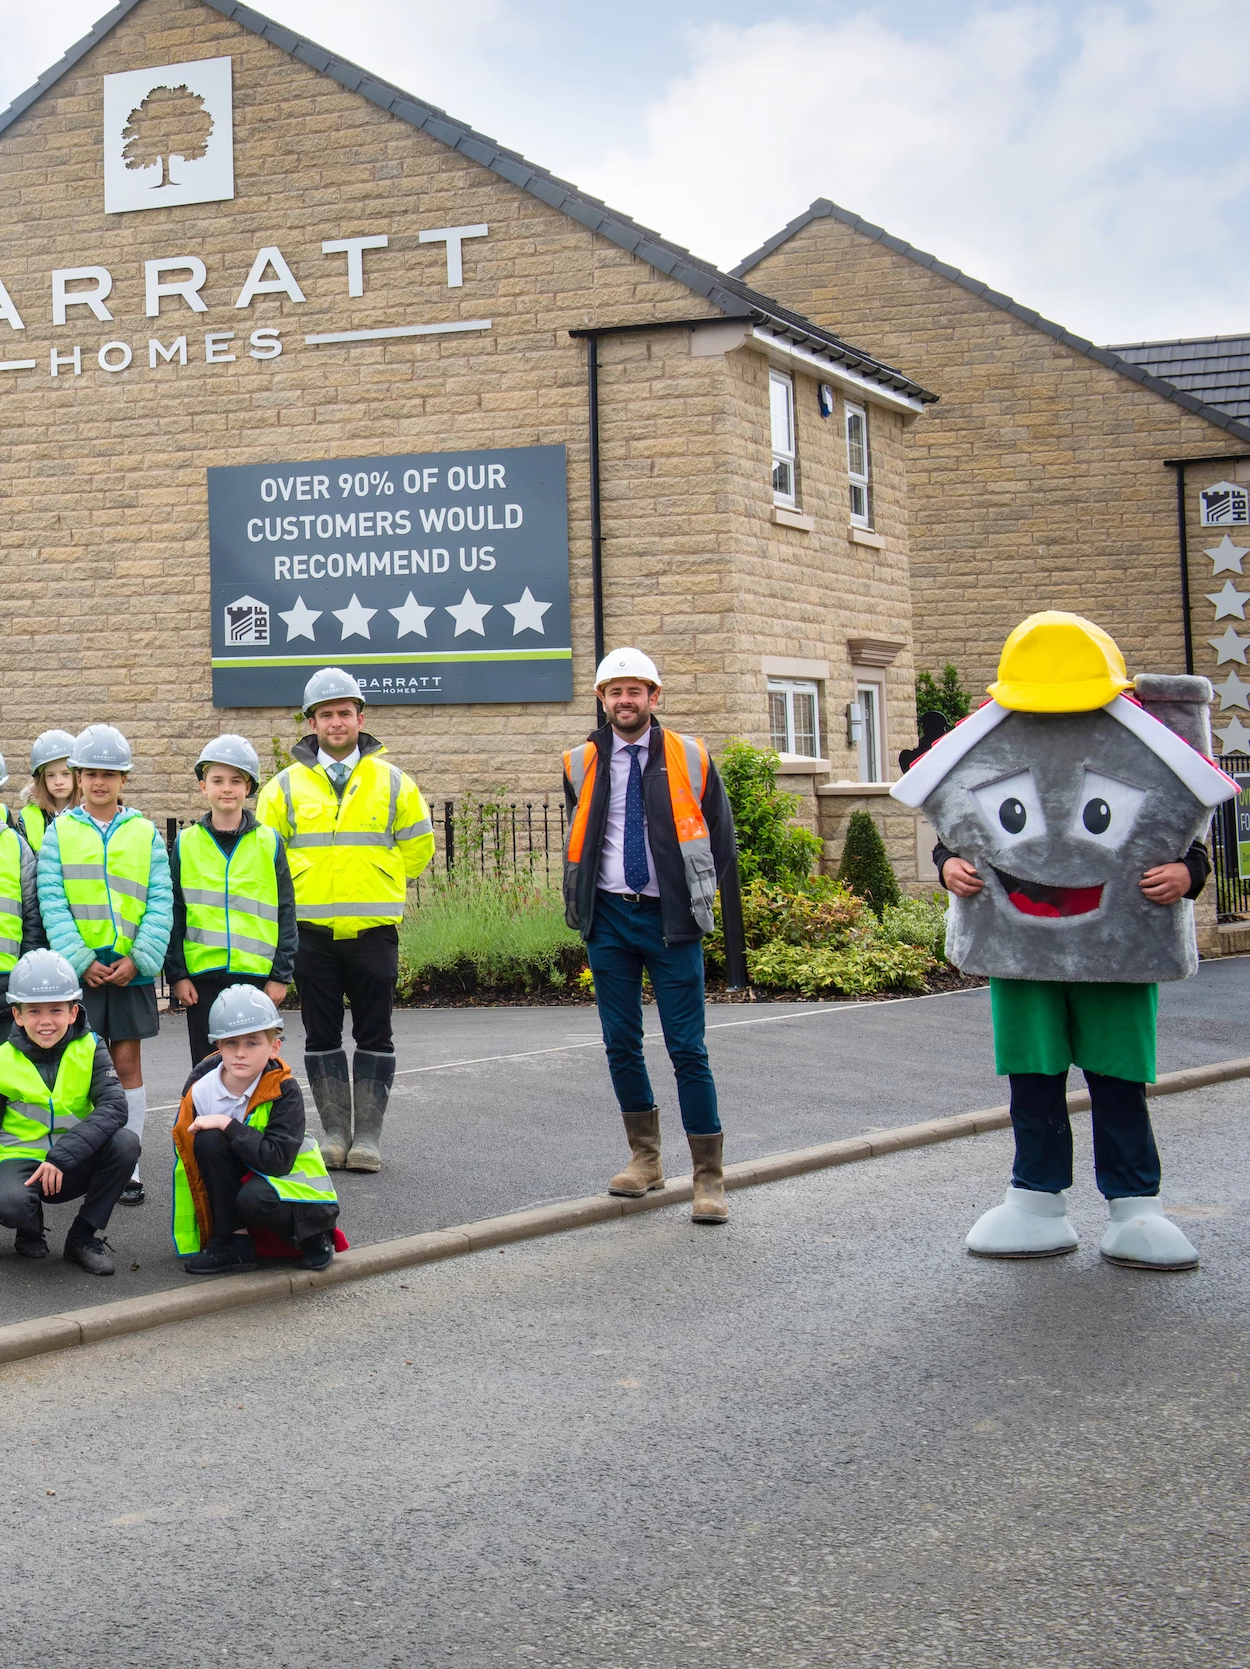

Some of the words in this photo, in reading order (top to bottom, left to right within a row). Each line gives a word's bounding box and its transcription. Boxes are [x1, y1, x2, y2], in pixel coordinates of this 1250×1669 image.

[50, 328, 283, 376] HOMES
[260, 475, 330, 502] OVER
[338, 471, 394, 498] 90%
[403, 468, 438, 494] OF
[448, 464, 506, 492] OUR
[1232, 491, 1246, 520] HBF
[247, 510, 411, 542] CUSTOMERS
[419, 504, 523, 533] WOULD
[274, 548, 450, 580] RECOMMEND
[460, 546, 496, 572] US
[254, 606, 268, 640] HBF
[357, 676, 442, 688] BARRATT
